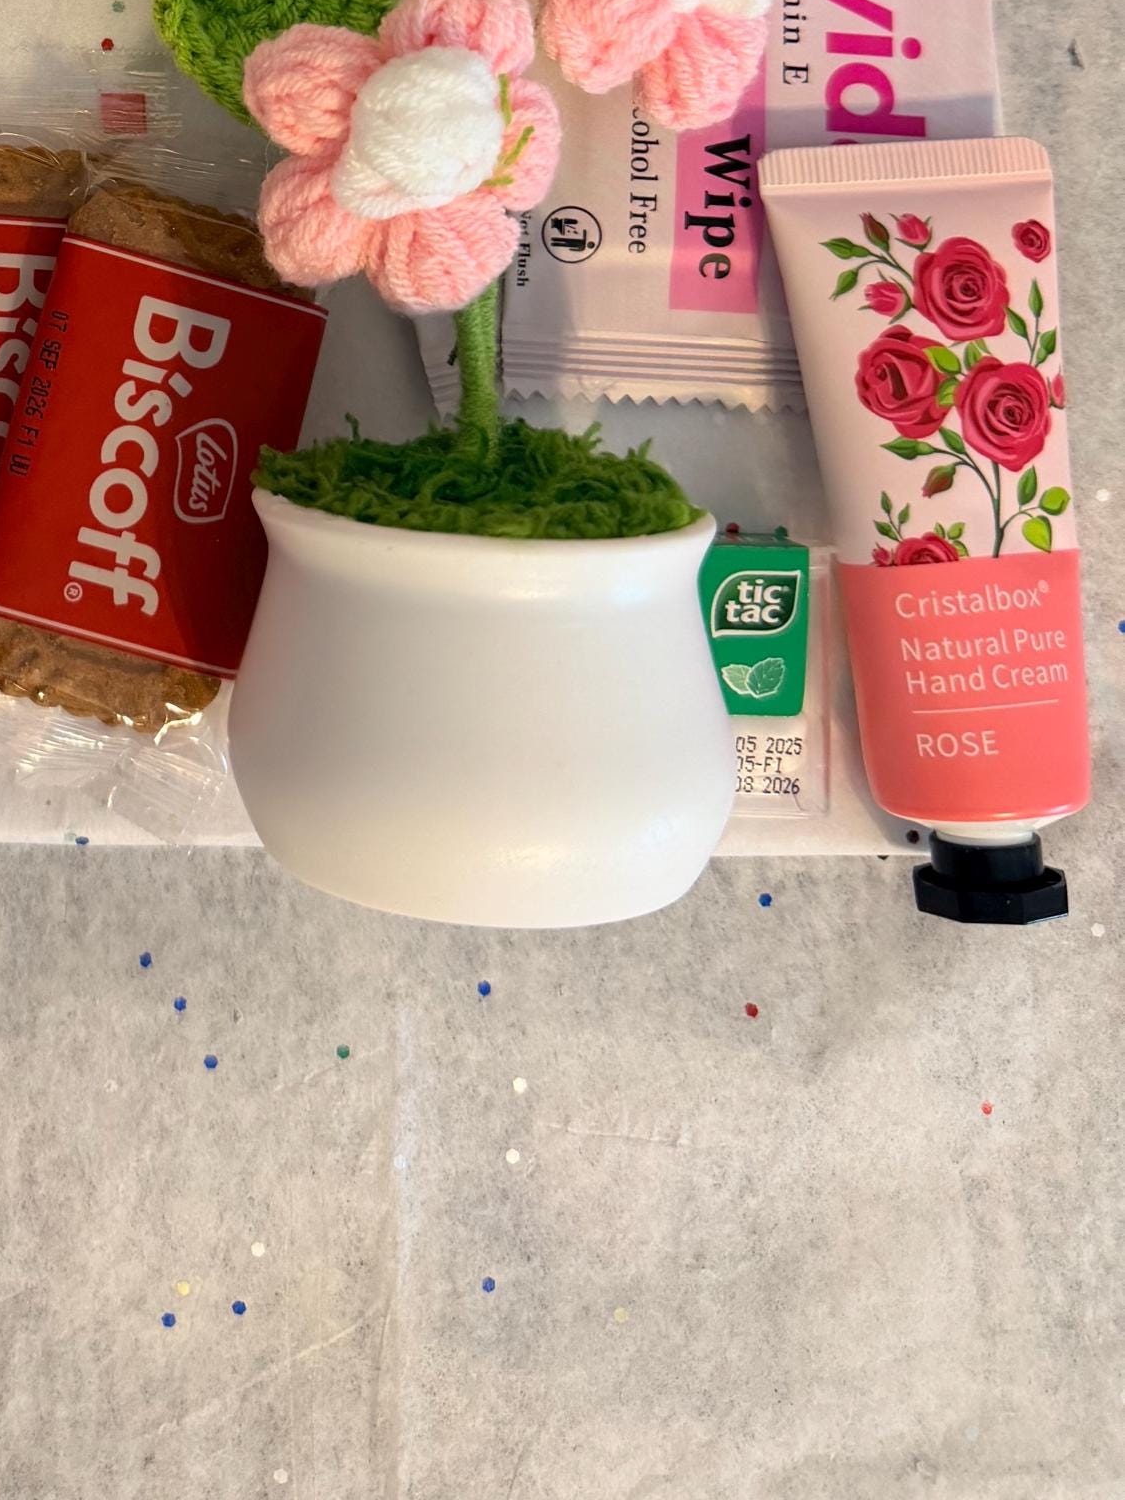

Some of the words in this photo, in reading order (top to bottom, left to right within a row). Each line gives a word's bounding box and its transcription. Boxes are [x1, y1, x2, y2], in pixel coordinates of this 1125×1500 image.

[782, 62, 809, 85] E
[684, 134, 752, 280] Wipe
[628, 194, 657, 254] Free
[516, 243, 531, 288] Flush
[47, 310, 69, 333] 07
[39, 338, 62, 371] SEP
[24, 375, 52, 420] 2026
[725, 600, 781, 624] tac
[901, 628, 1009, 662] Natural
[1013, 628, 1066, 652] Pure
[905, 665, 986, 695] Hand
[992, 663, 1068, 689] Cream
[765, 736, 802, 755] 2025
[916, 730, 999, 758] ROSE
[762, 776, 800, 795] 2026
